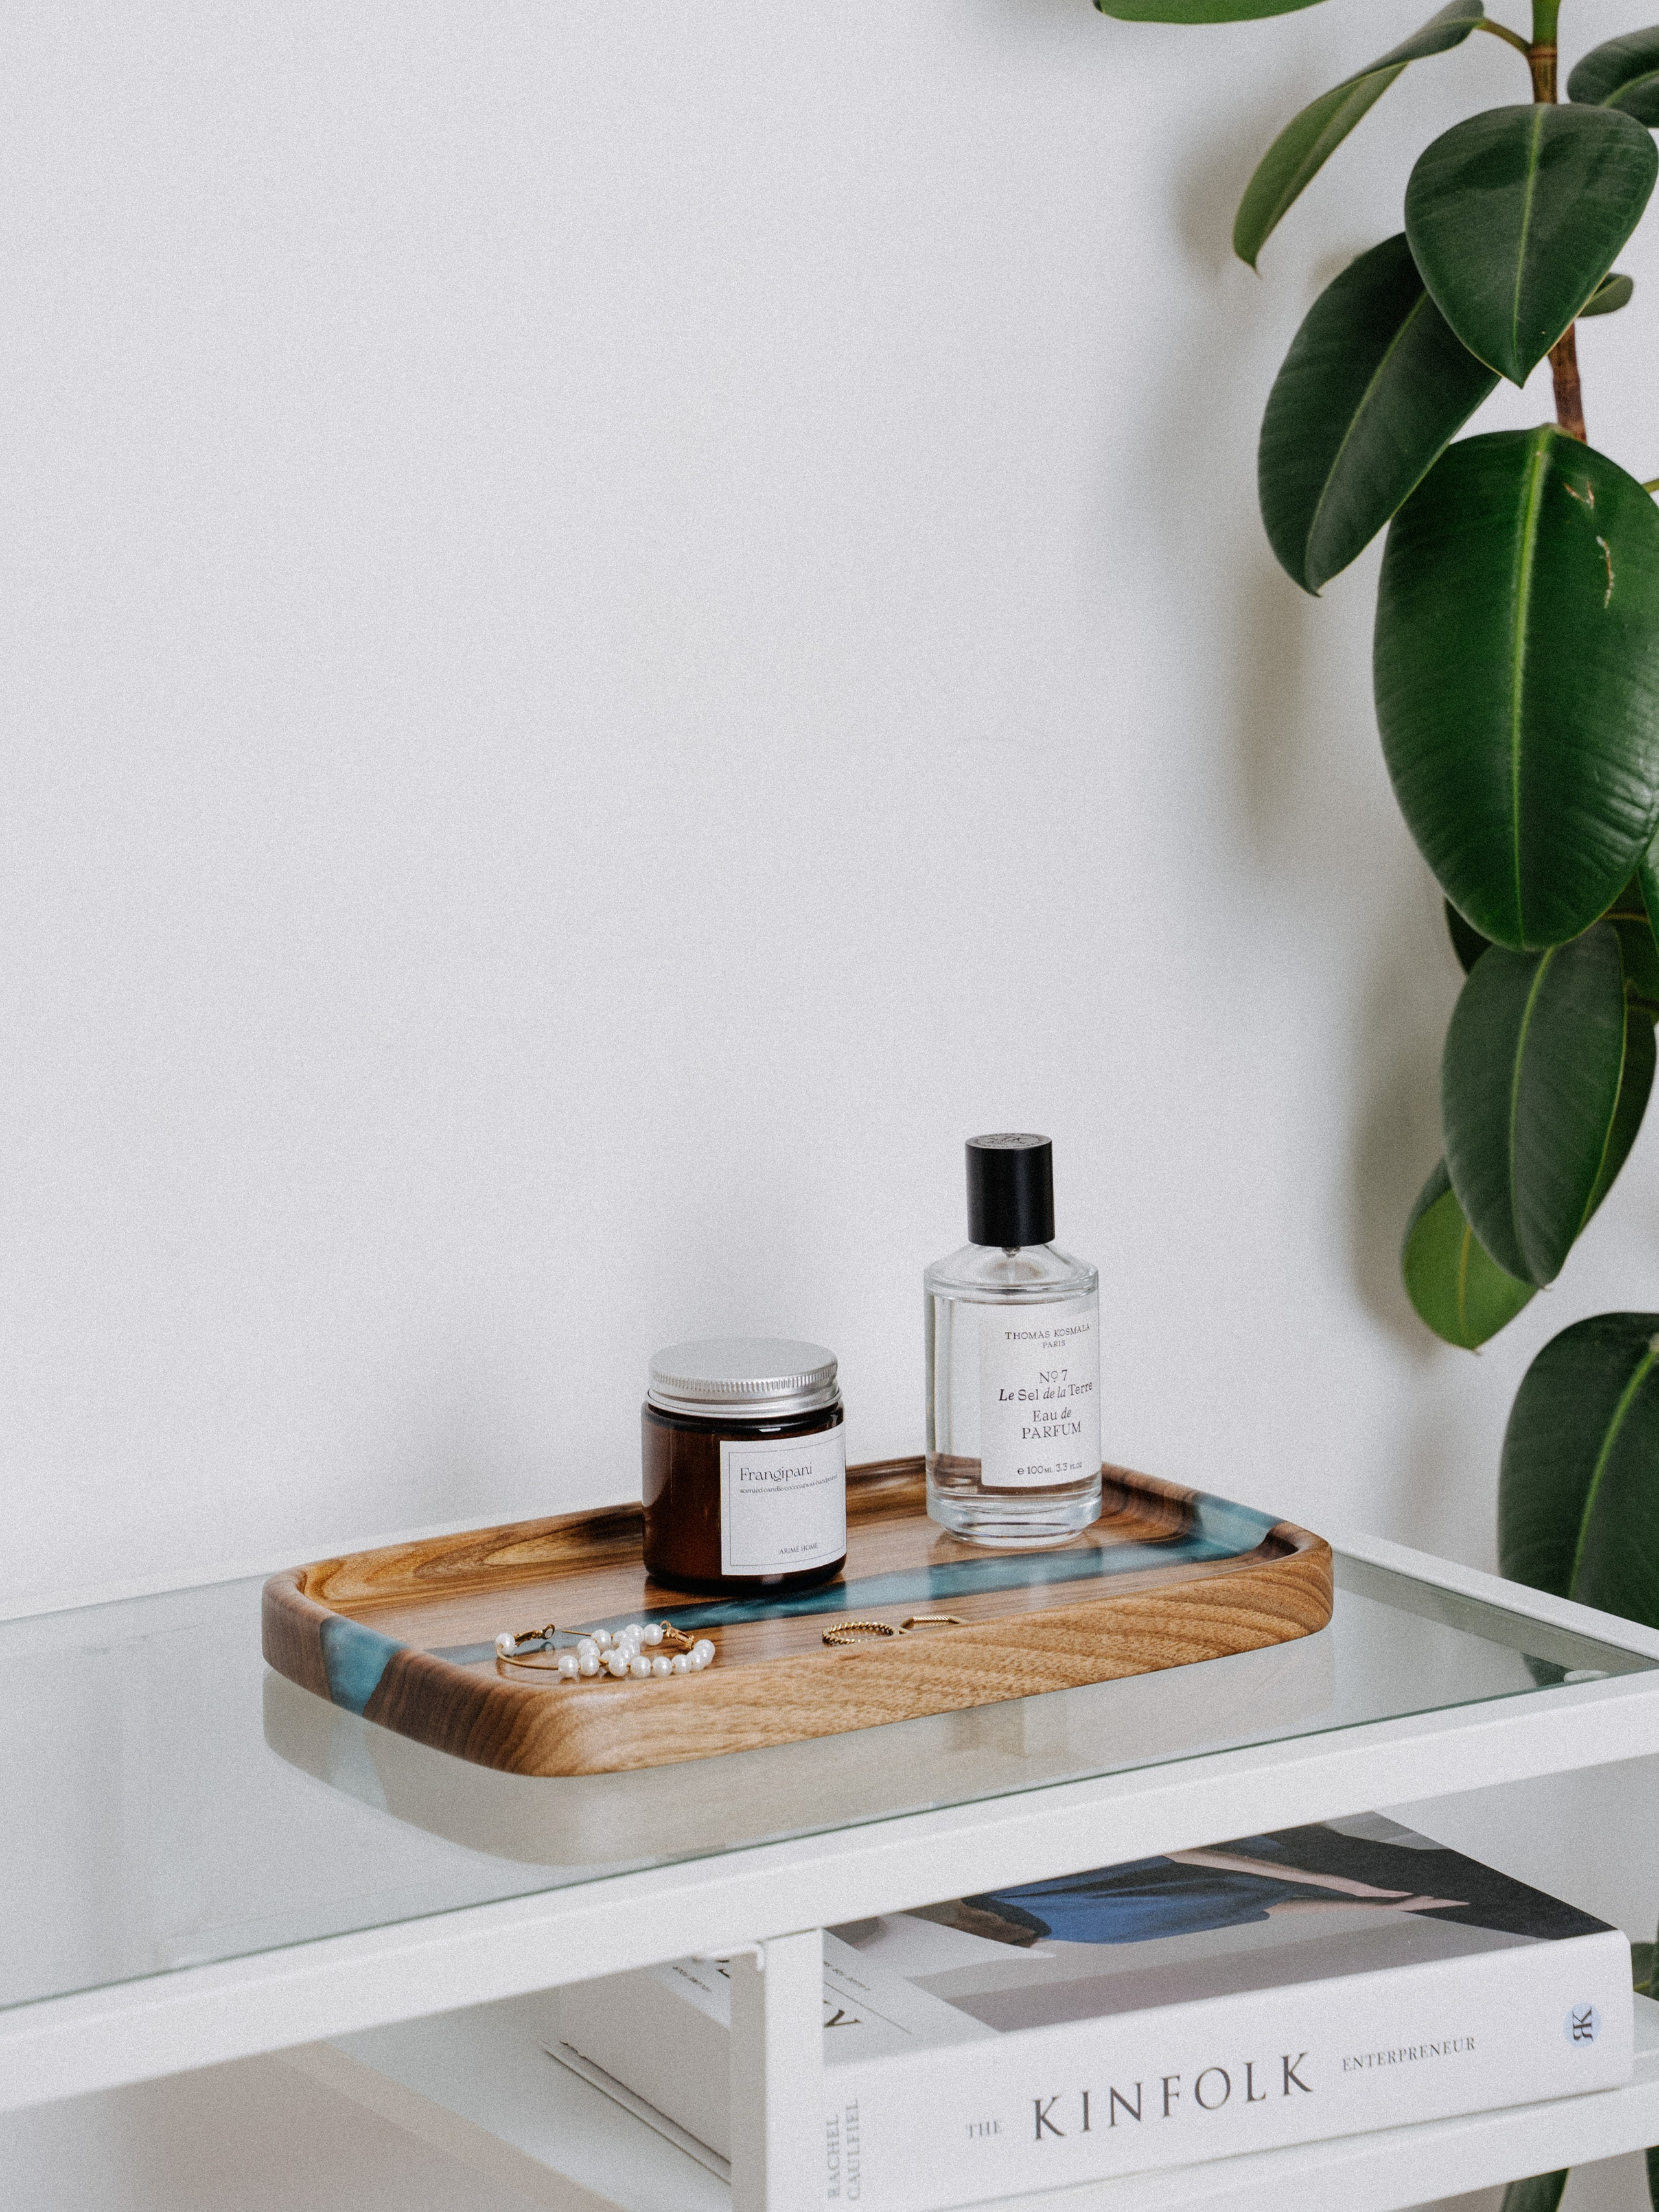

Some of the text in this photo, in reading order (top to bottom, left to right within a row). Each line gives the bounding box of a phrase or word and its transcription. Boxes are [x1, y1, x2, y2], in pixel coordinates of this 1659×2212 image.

[1005, 1323, 1091, 1340] THOMAS KOSMALA
[1043, 1340, 1066, 1349] PARIS
[1062, 1369, 1068, 1381] 7
[999, 1382, 1093, 1401] Le Sel de la Terre
[1033, 1406, 1072, 1422] Eau de
[1022, 1420, 1082, 1439] PARFUM
[740, 1461, 813, 1482] Frangipani
[1056, 1462, 1068, 1472] 3.3
[801, 1542, 818, 1552] HOME
[965, 2036, 1476, 2141] THE KINFOLK ENTERPRENEUR
[826, 2114, 841, 2199] RACHEL
